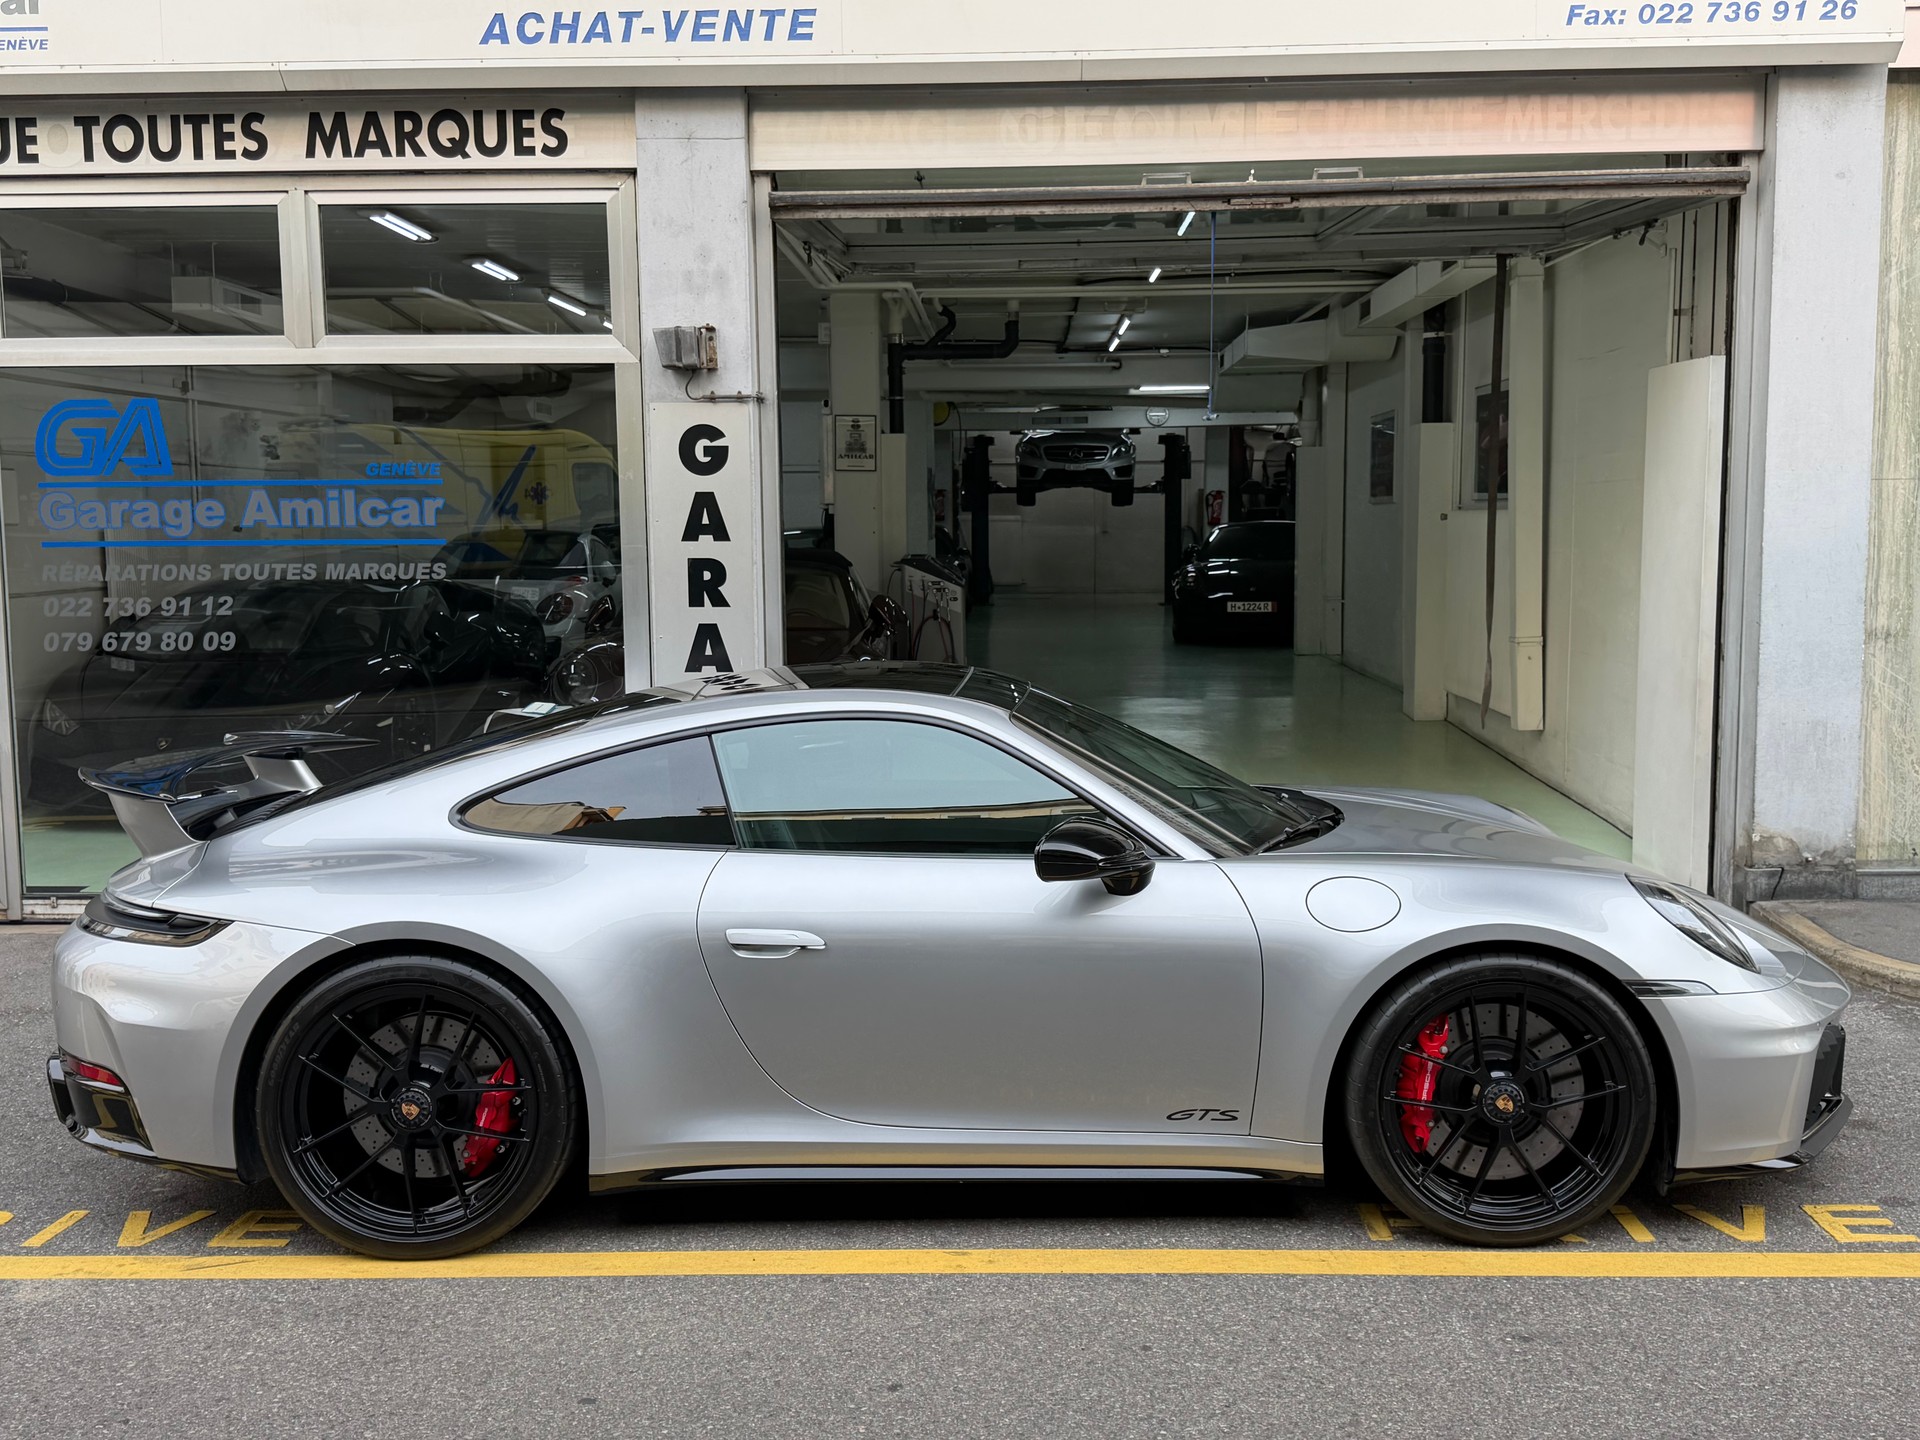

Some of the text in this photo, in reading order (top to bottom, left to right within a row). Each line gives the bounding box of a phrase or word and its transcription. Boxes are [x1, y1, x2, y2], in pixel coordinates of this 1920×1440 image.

[1566, 0, 1858, 26] Fax: 022 736 91 26
[479, 8, 817, 45] ACHAT-VENTE
[73, 113, 268, 163] TOUTES
[305, 108, 568, 160] MARQUES
[35, 398, 174, 477] GA
[366, 460, 441, 477] GENÈVE
[38, 488, 446, 538] Garage Amilcar
[42, 562, 447, 582] RÉPARATIONS TOUTES MARQUES
[43, 596, 234, 617] 022 736 91 12
[43, 631, 236, 652] 079 679 80 09
[1166, 1109, 1240, 1121] GTS
[0, 1210, 303, 1248] IVE
